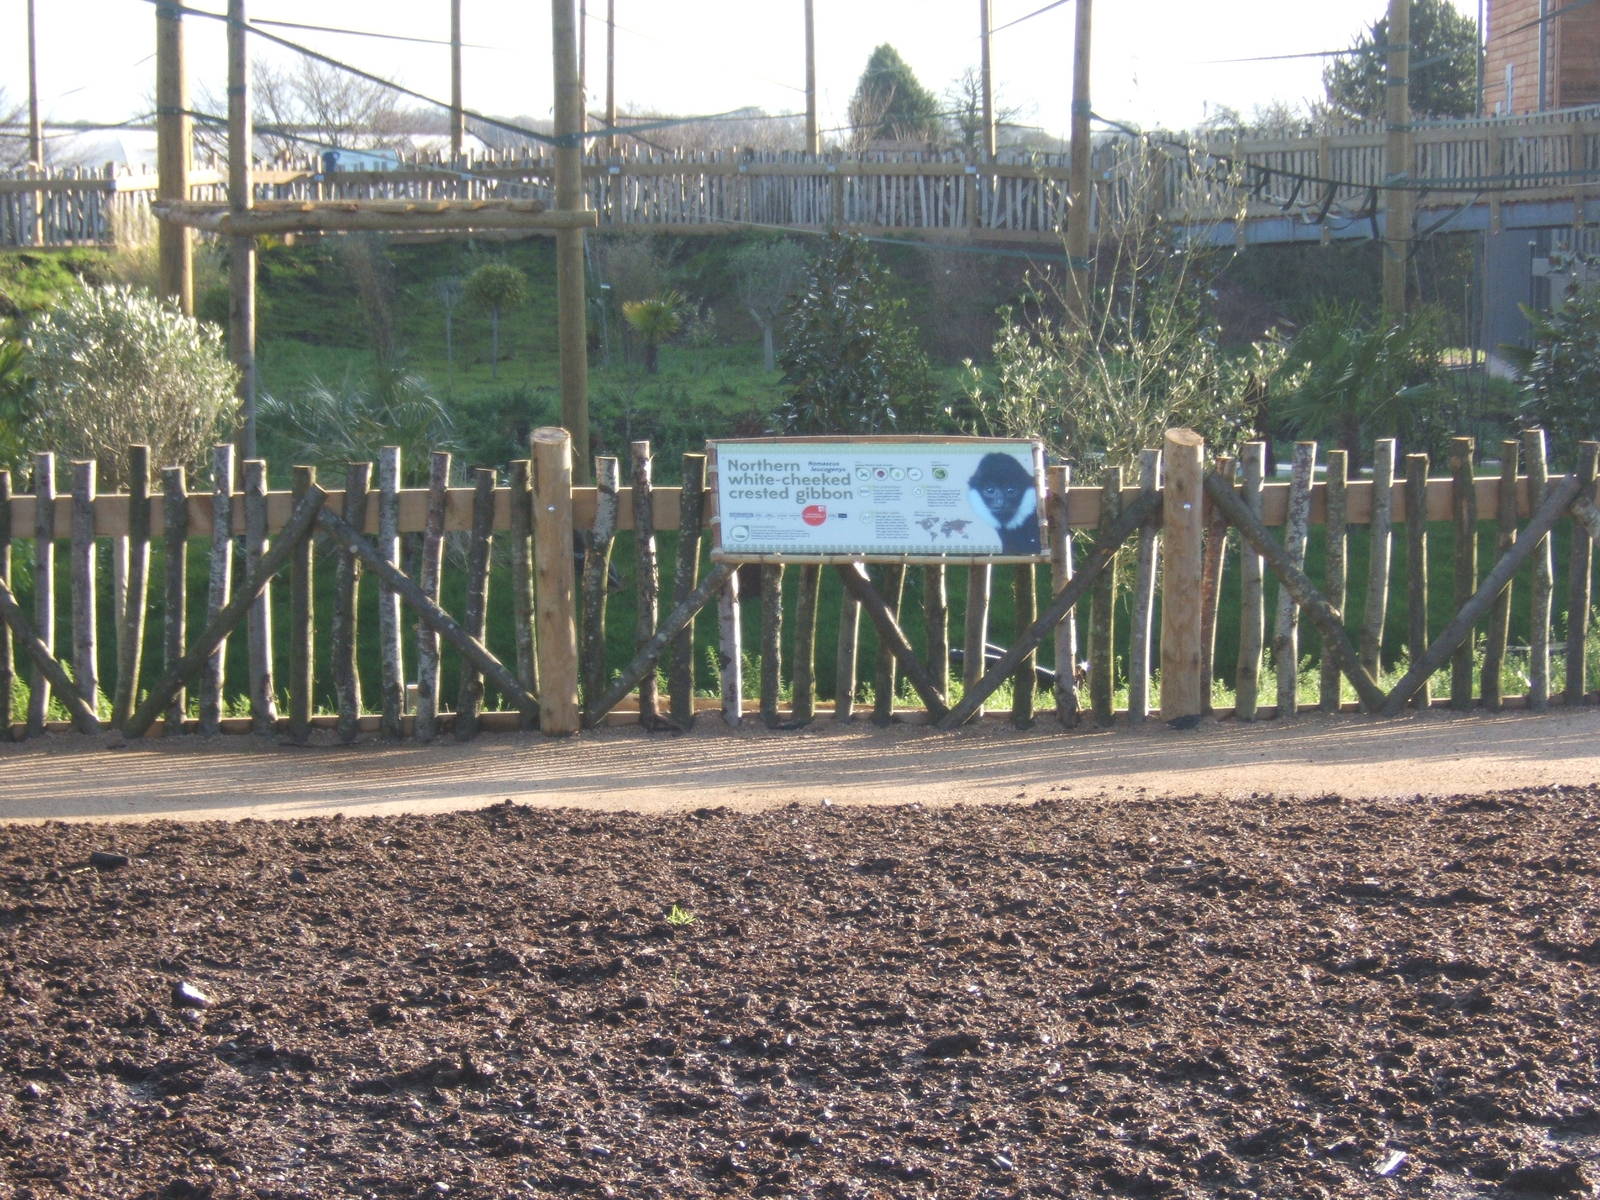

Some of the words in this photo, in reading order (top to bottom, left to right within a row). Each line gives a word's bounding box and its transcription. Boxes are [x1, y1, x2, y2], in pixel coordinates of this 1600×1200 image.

[728, 459, 800, 472] Northern
[728, 473, 851, 486] white-cheeked
[729, 487, 789, 500] crested
[796, 487, 853, 504] gibbon
